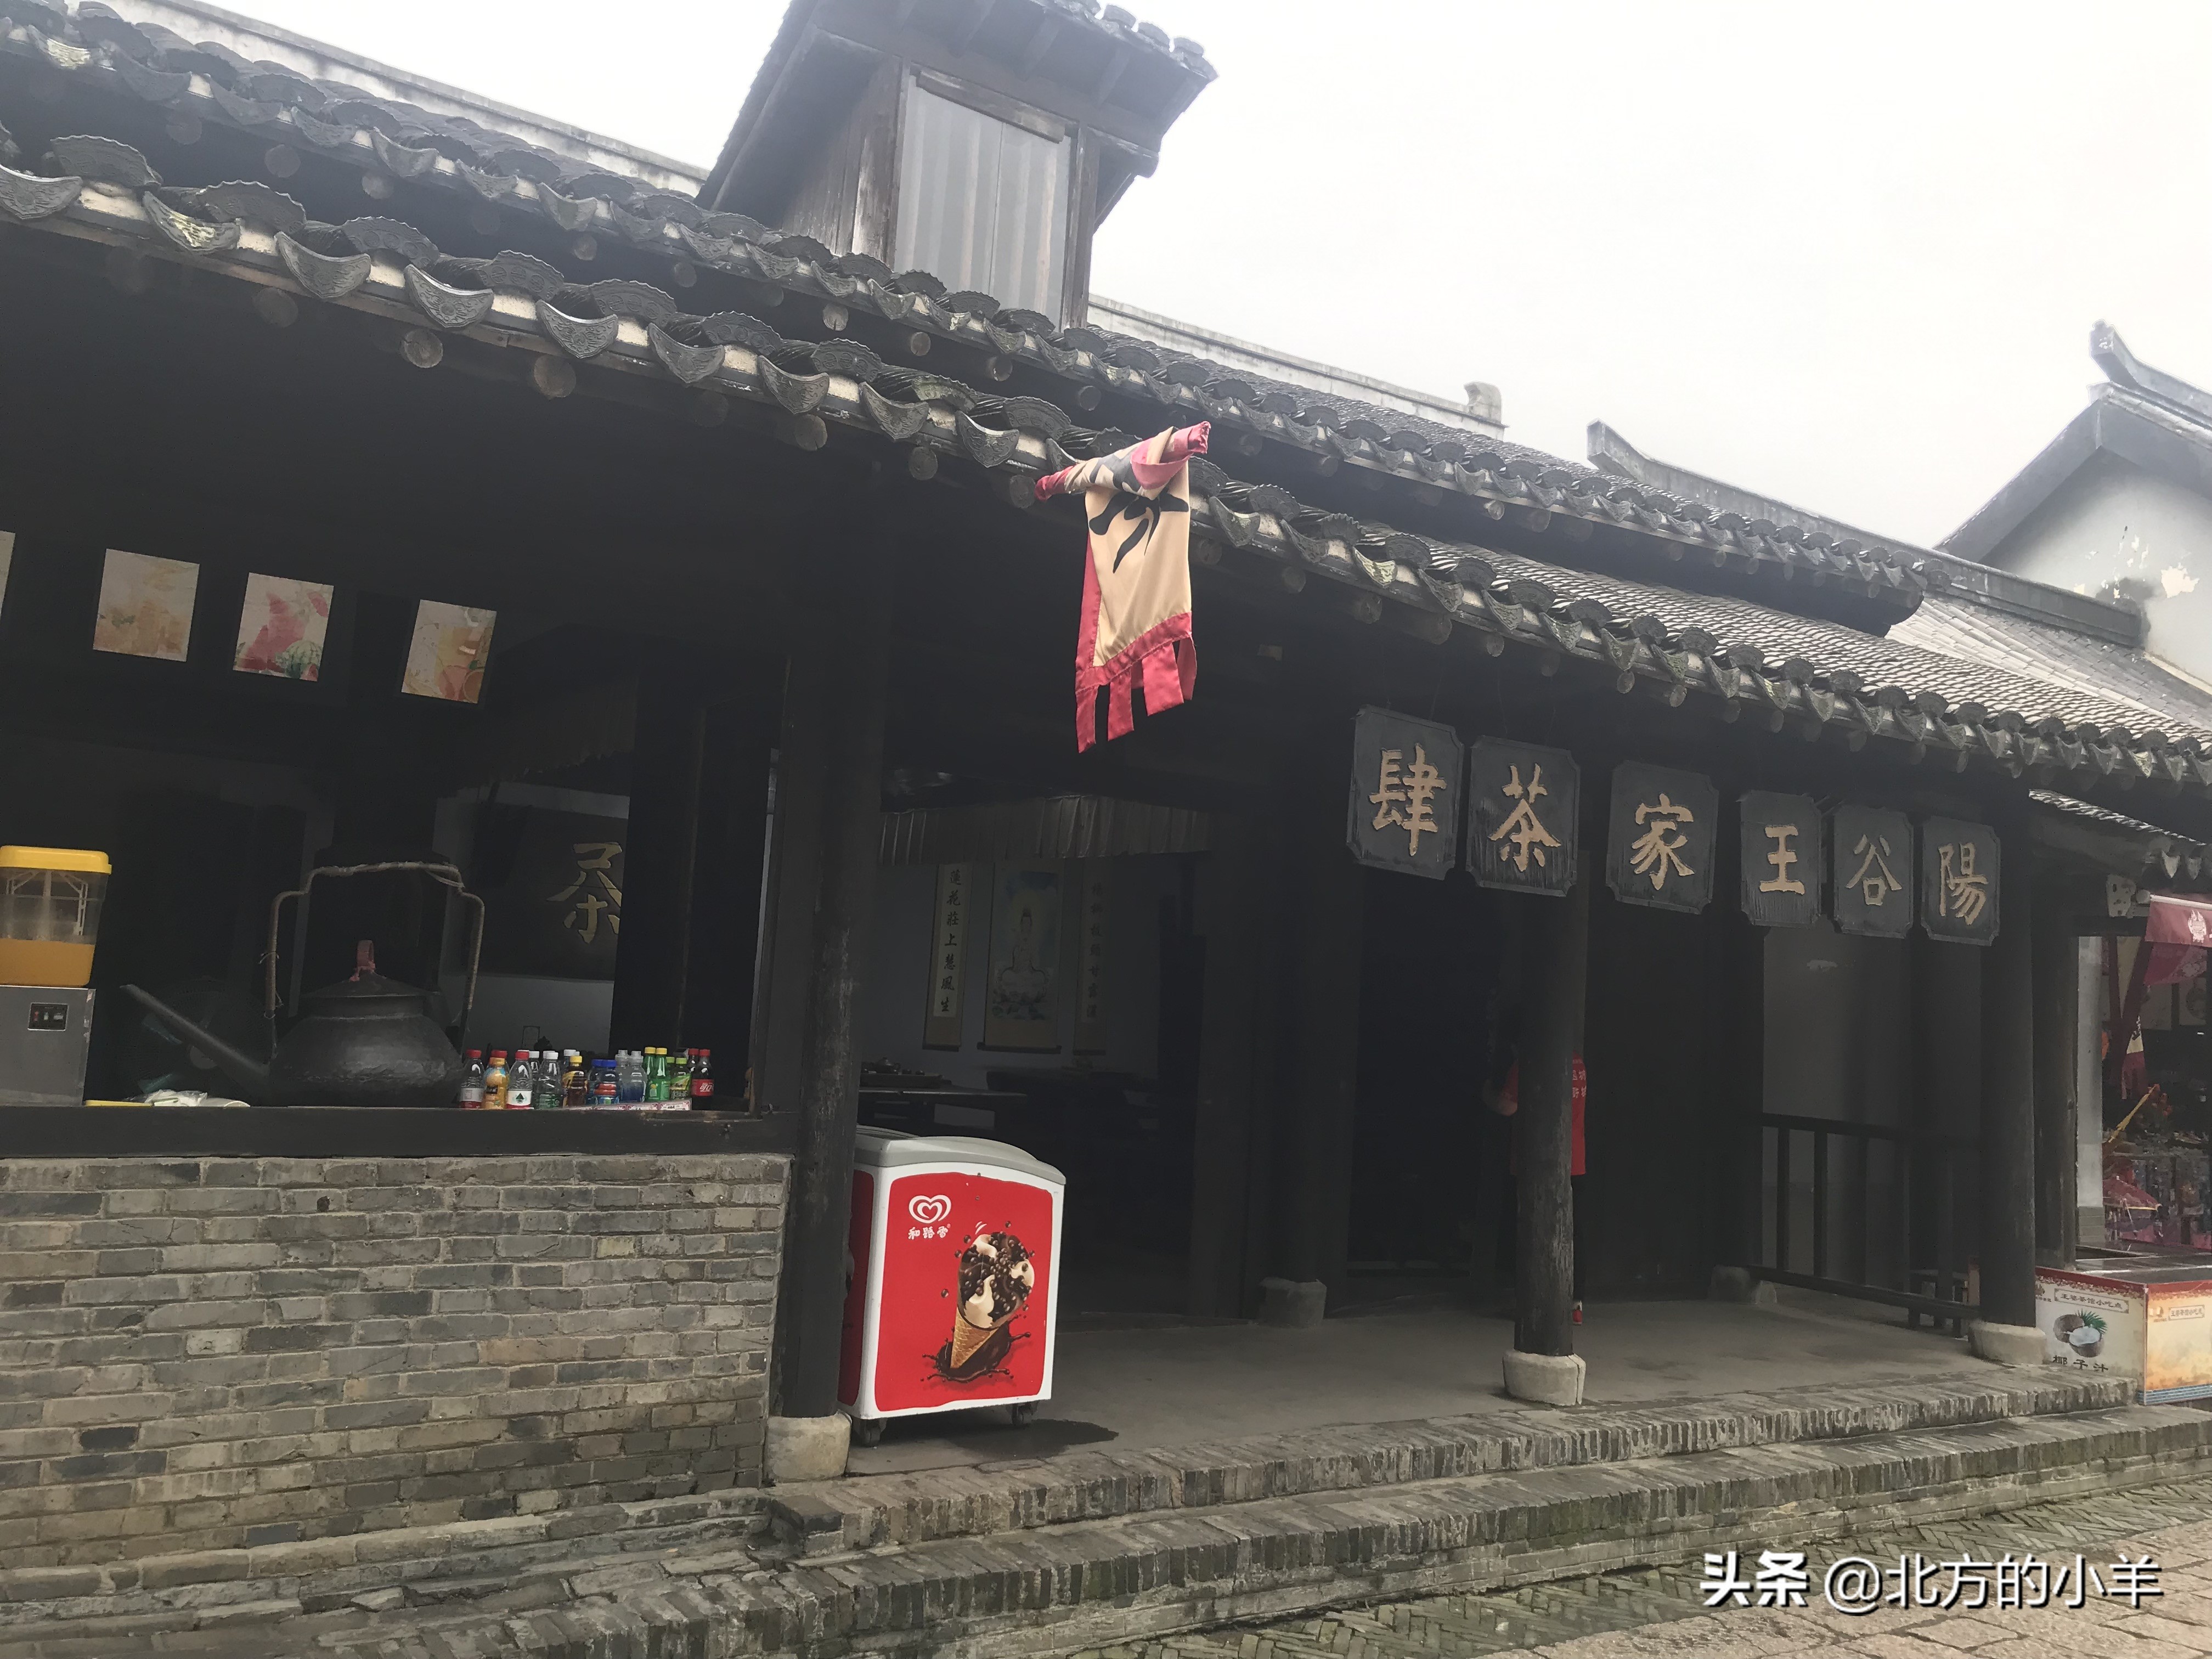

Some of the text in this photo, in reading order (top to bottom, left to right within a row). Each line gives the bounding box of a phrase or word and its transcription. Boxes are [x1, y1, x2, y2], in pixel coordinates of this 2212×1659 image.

[908, 1226, 949, 1240] 和路雪
[2052, 1355, 2109, 1373] 椰子汁
